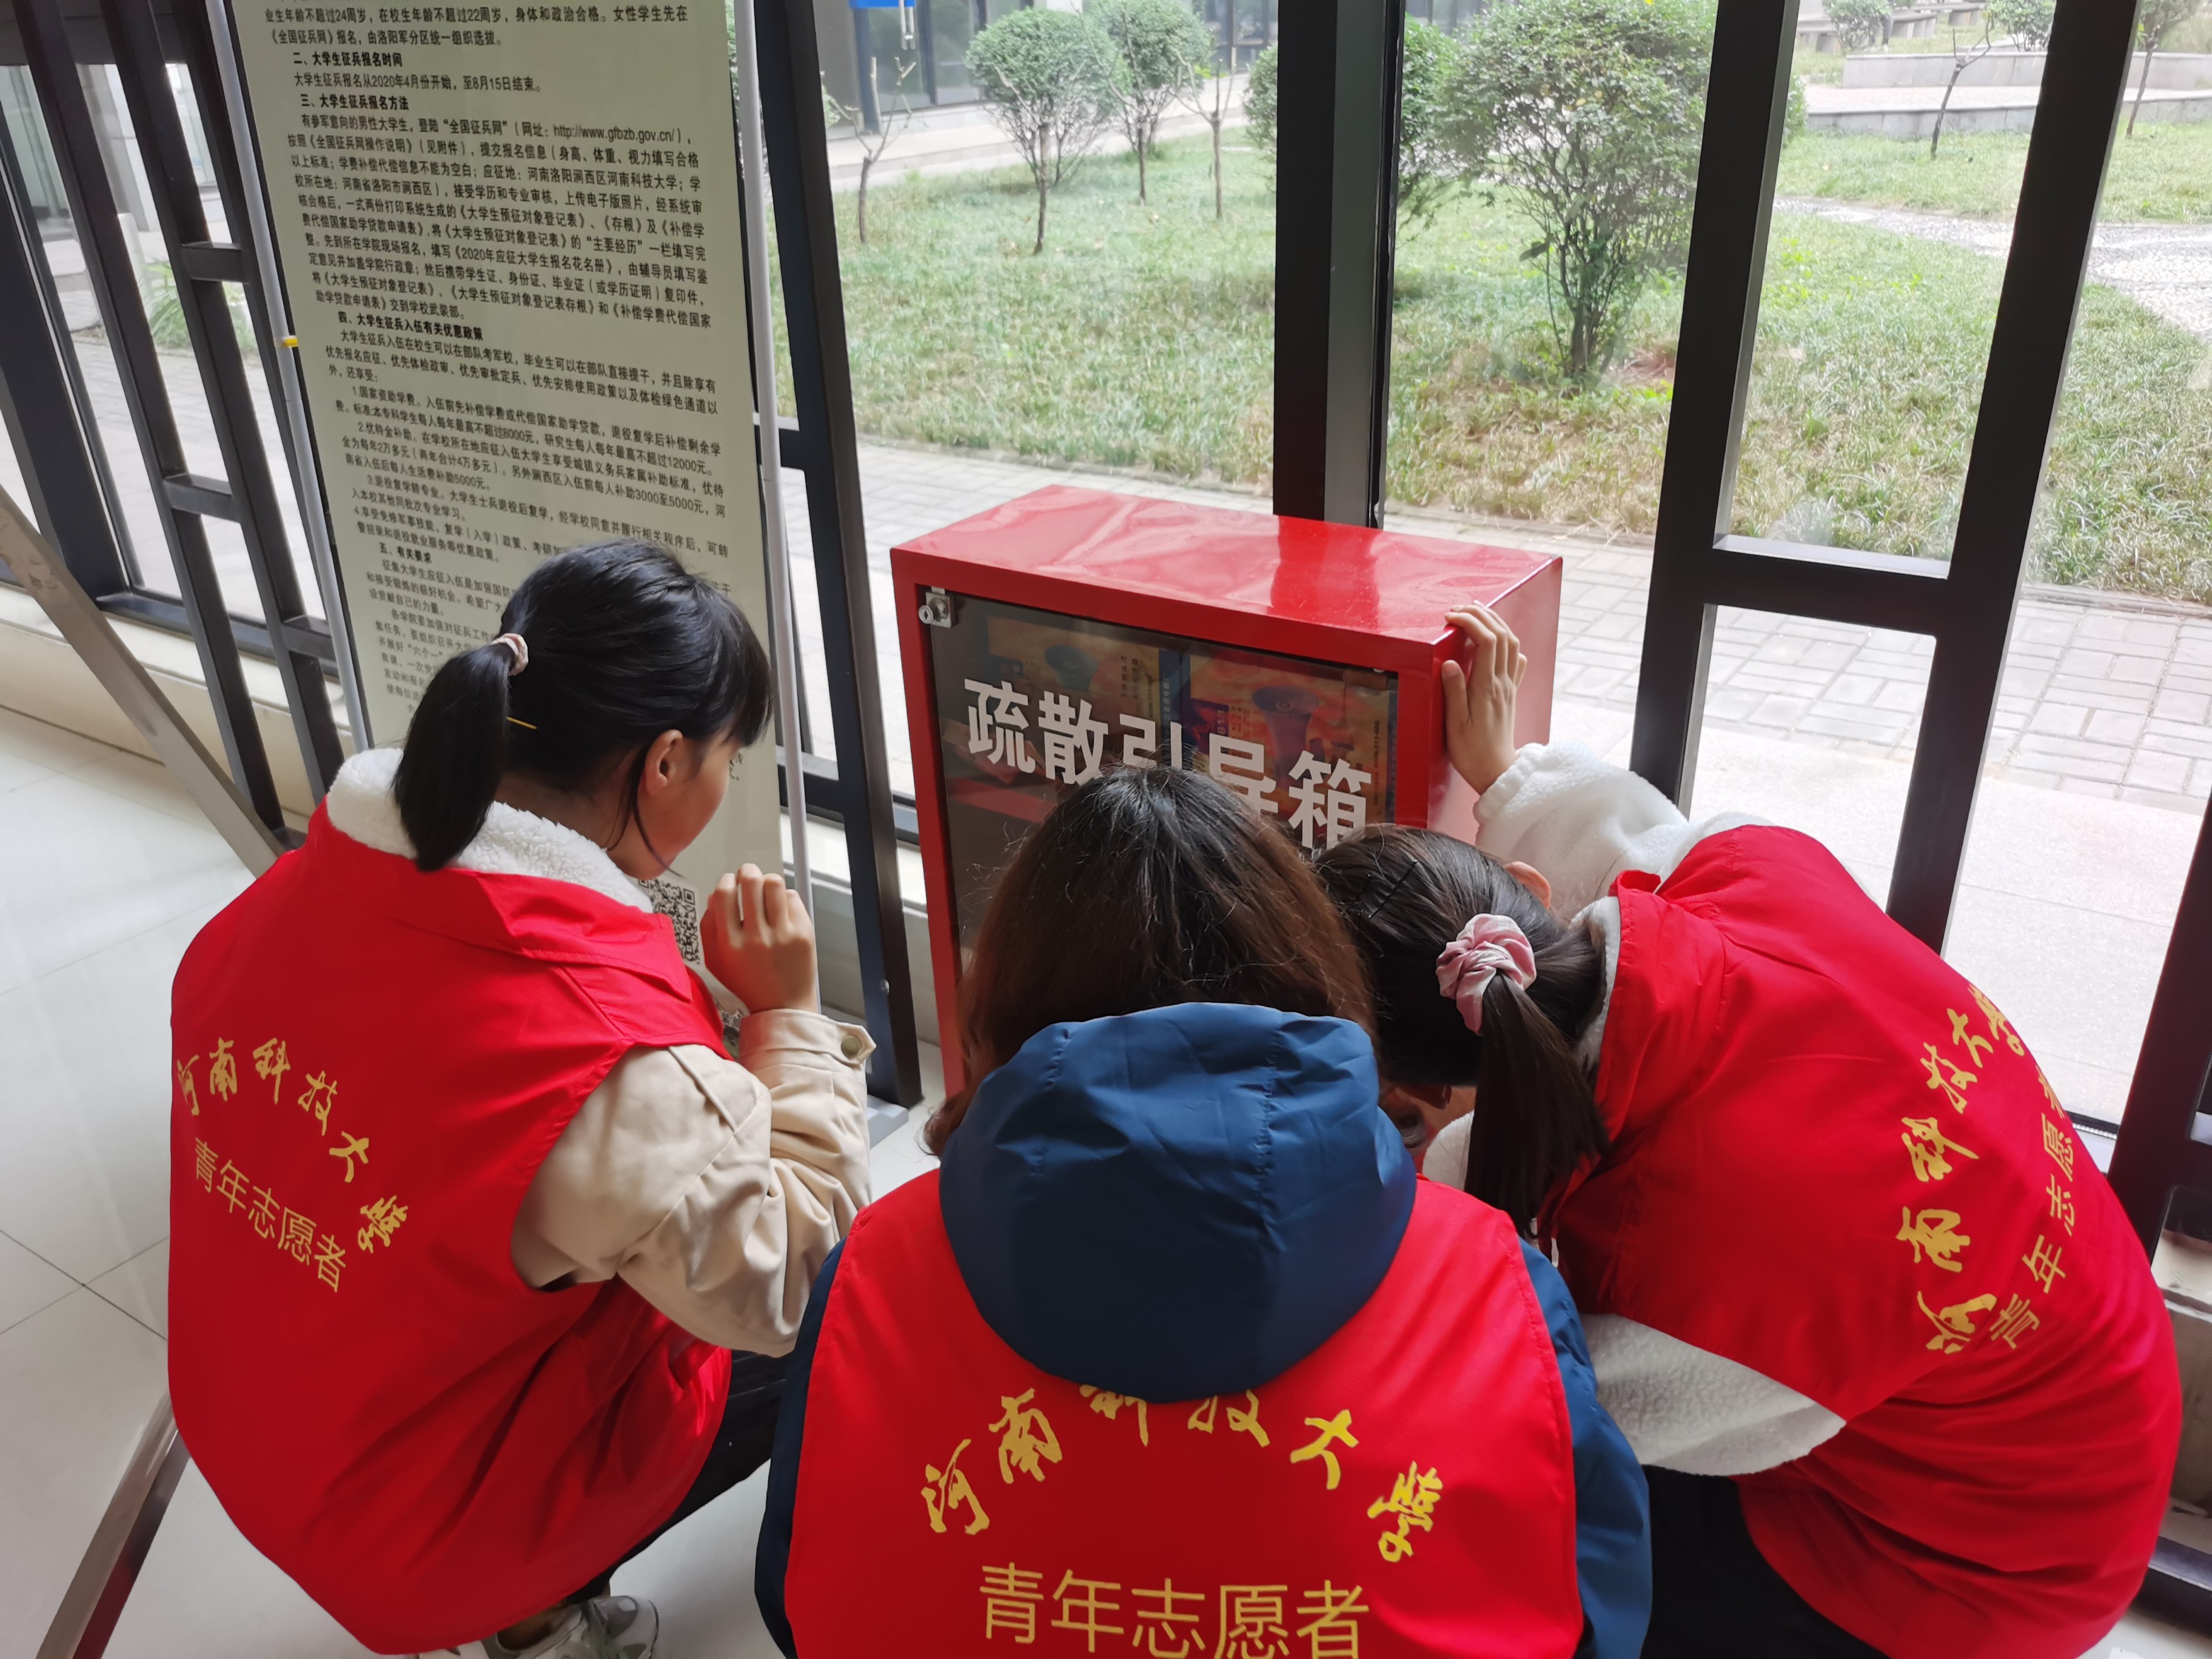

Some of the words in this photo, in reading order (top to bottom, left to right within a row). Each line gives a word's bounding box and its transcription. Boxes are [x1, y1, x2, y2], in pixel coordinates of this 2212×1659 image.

[293, 51, 403, 67] 二、大学生征兵报名时间
[300, 93, 409, 110] 三、大学生征兵报名方法
[195, 1137, 346, 1293] 青年志愿者
[979, 1562, 1369, 1659] 青年志愿者
